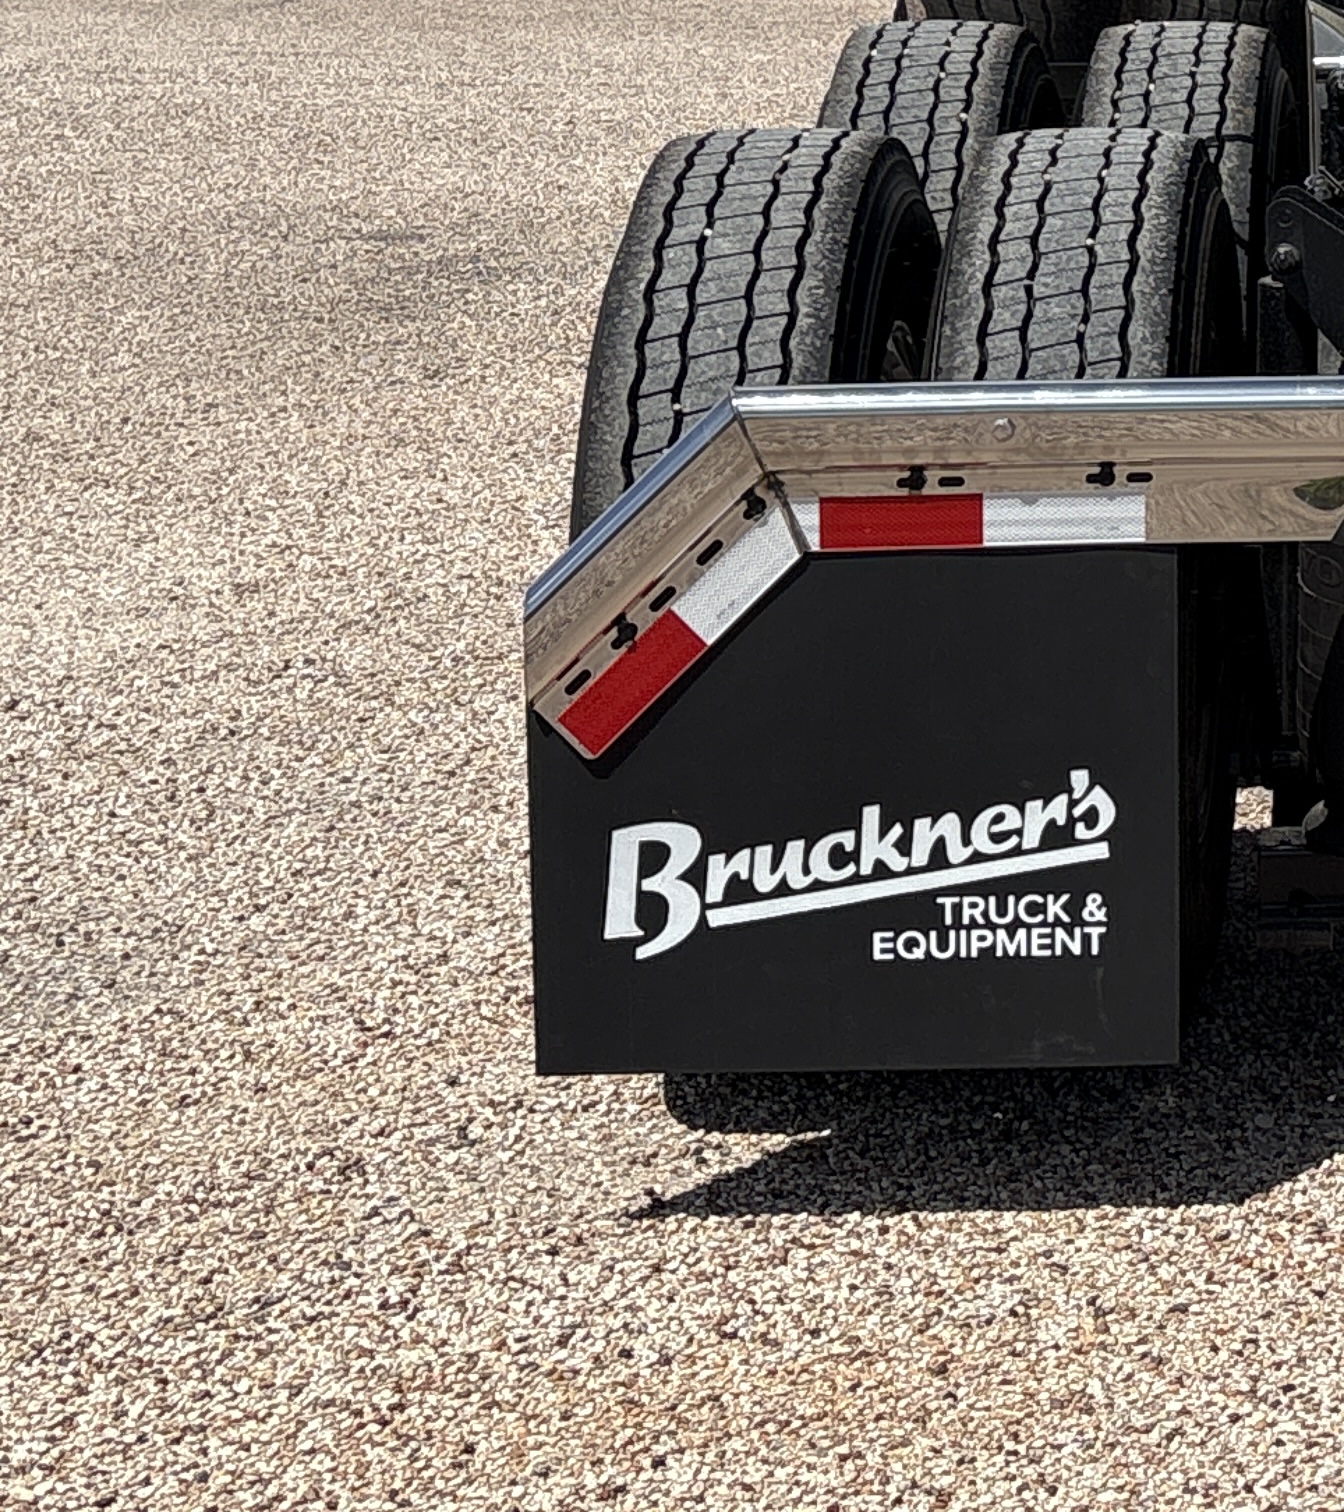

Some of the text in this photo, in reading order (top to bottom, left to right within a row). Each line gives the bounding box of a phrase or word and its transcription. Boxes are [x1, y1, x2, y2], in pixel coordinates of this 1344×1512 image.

[603, 768, 1116, 961] Bruckner's
[935, 892, 1108, 926] TRUCK &
[872, 926, 1107, 961] EQUIPMENT
